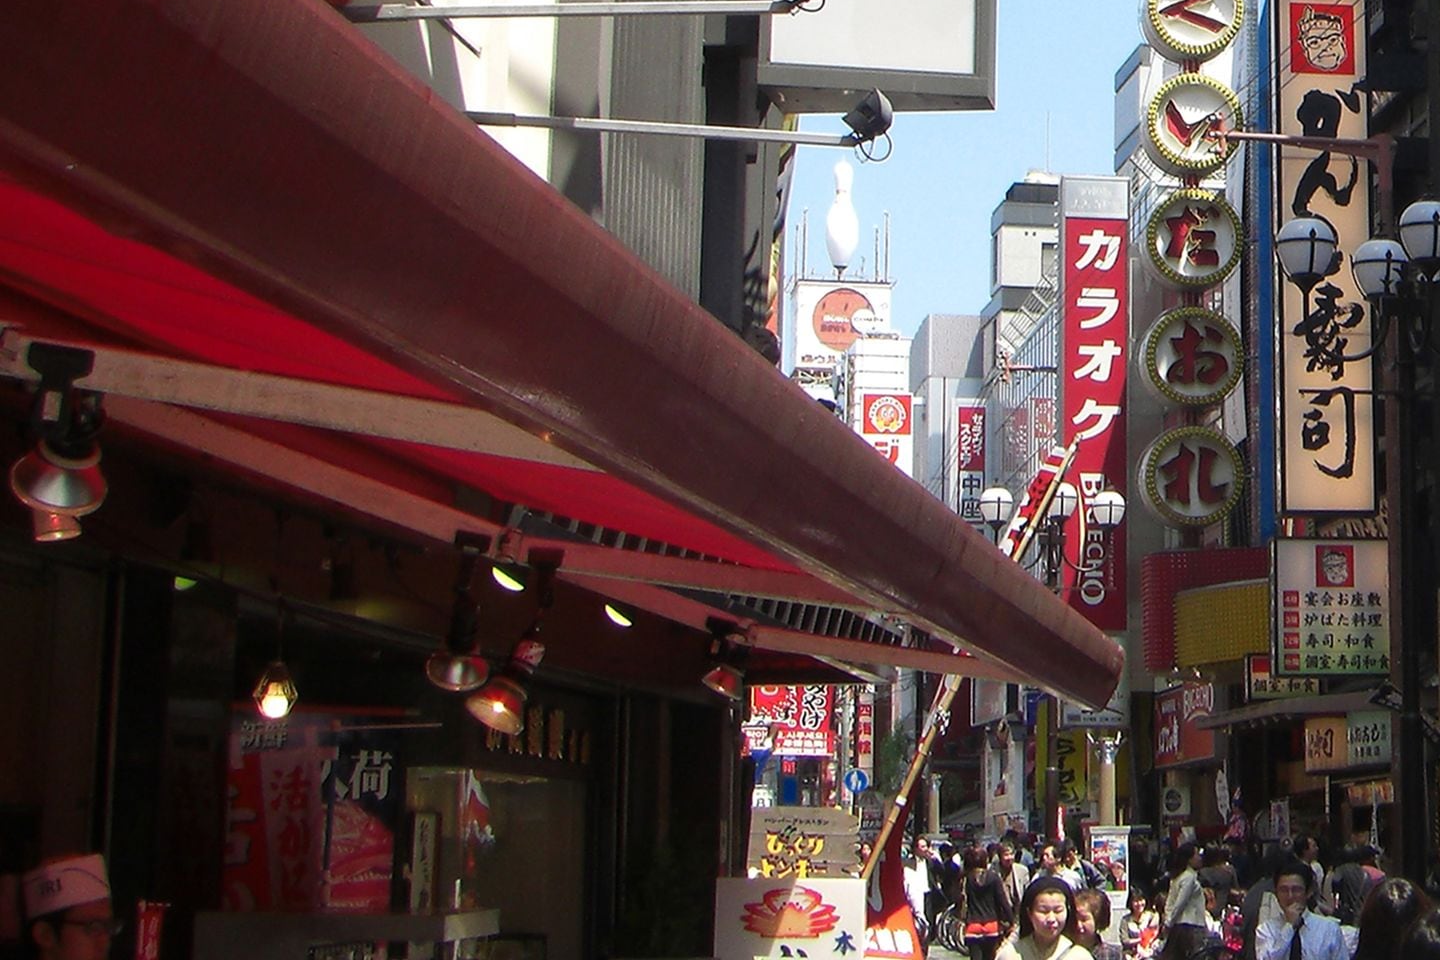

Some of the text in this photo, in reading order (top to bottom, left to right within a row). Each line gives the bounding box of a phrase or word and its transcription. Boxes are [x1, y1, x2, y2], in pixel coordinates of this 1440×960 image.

[1072, 229, 1121, 441] カラオケ
[1304, 591, 1382, 607] 宴会お座敷
[1304, 612, 1382, 627] 炉ばた料理
[766, 826, 825, 857] びっくり
